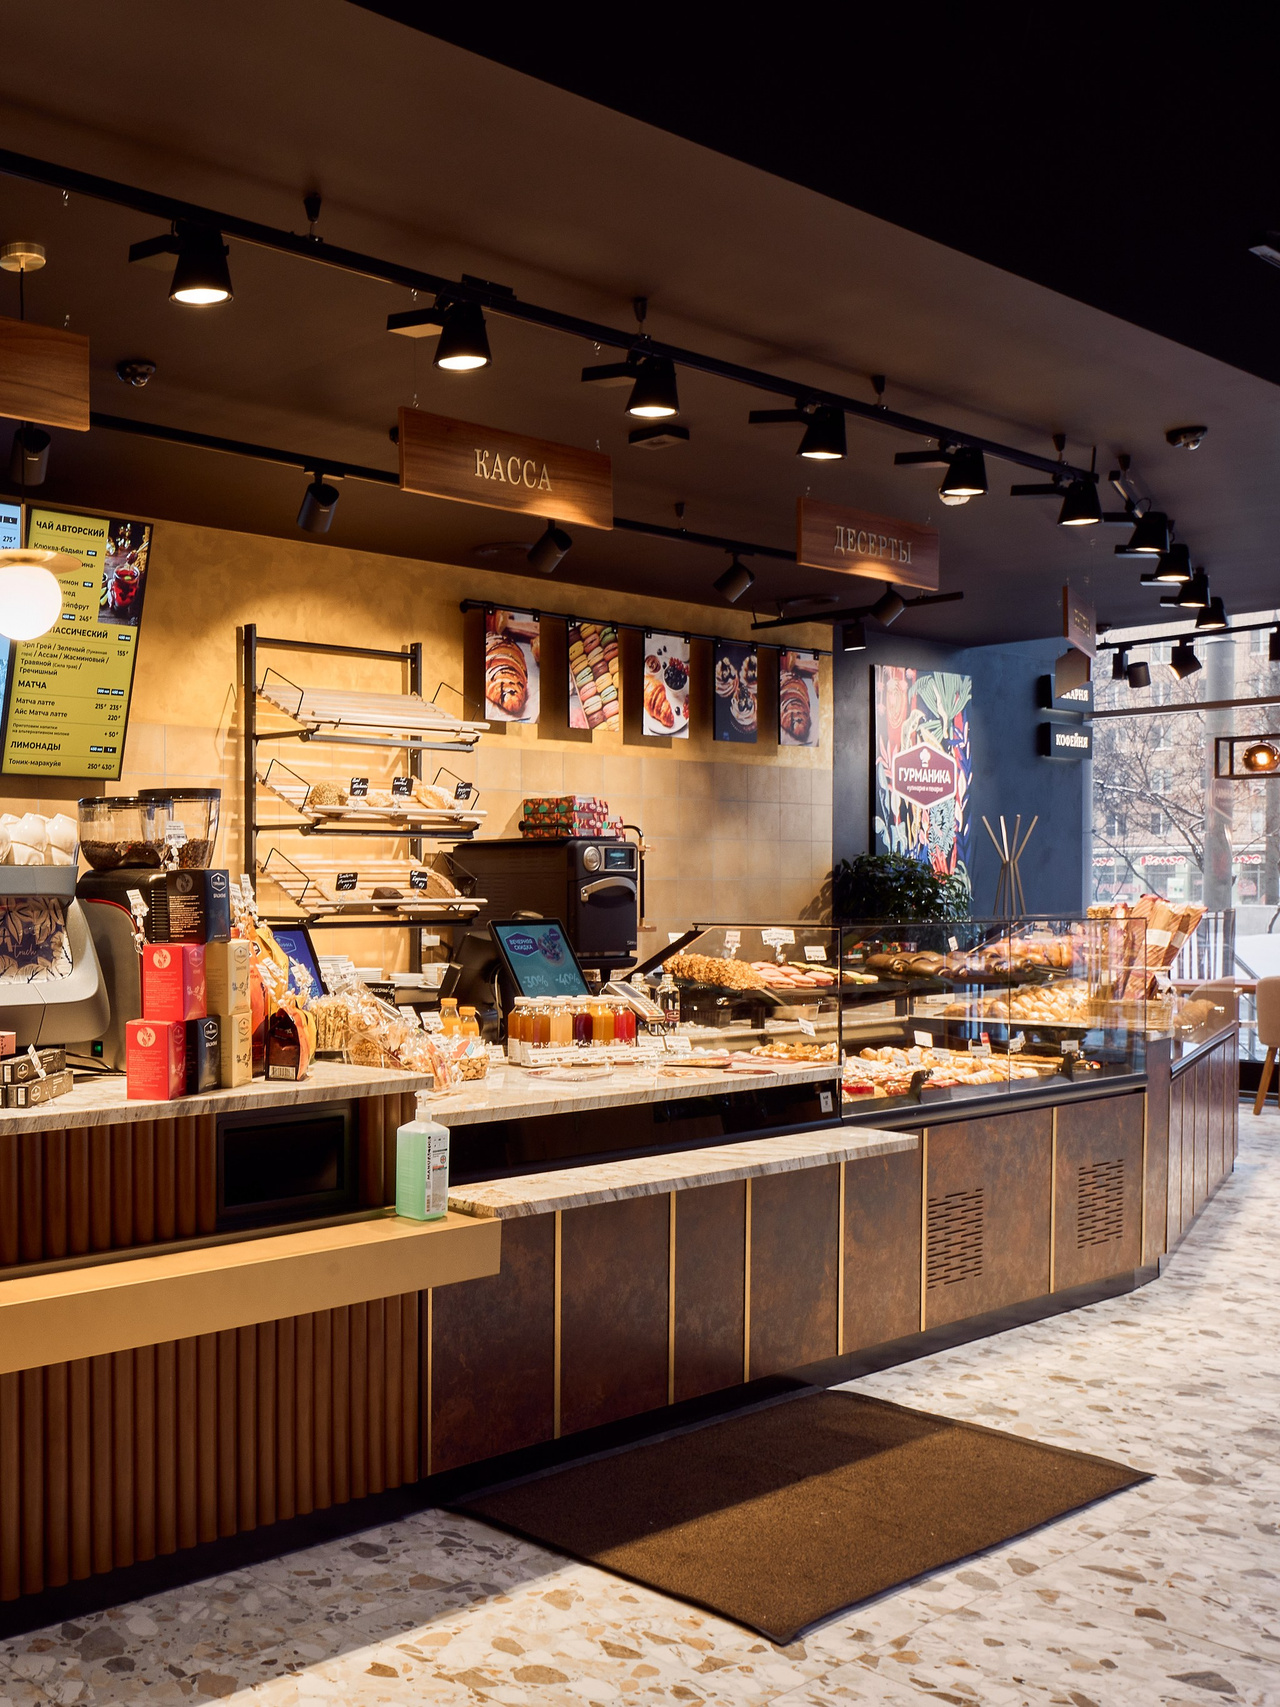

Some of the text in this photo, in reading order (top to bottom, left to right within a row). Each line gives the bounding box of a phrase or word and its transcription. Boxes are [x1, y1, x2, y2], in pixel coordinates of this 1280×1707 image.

[474, 448, 553, 492] КАССА
[36, 520, 105, 538] ЧАЙ АВТОРСКИЙ
[834, 525, 913, 565] ДЕСЕРТЫ
[48, 626, 108, 639] ЛАССИЧЕСКИЙ
[36, 642, 52, 650] Грей
[57, 644, 86, 653] Зеленый
[20, 658, 52, 667] Травяной
[38, 651, 58, 659] Ассам
[63, 653, 105, 664] Жасминовый
[19, 667, 58, 676] Гречишный
[17, 679, 47, 689] МАТЧА
[1061, 688, 1089, 702] КАРНЯ
[15, 697, 36, 706] Матча
[14, 707, 28, 715] Айс
[28, 709, 49, 717] Матча
[10, 740, 61, 751] ЛИМОНАДЫ
[1055, 732, 1089, 748] КОФЕЙНЯ
[8, 758, 62, 768] Тоник-маракуйя
[898, 767, 952, 784] ГУРМАНИКА
